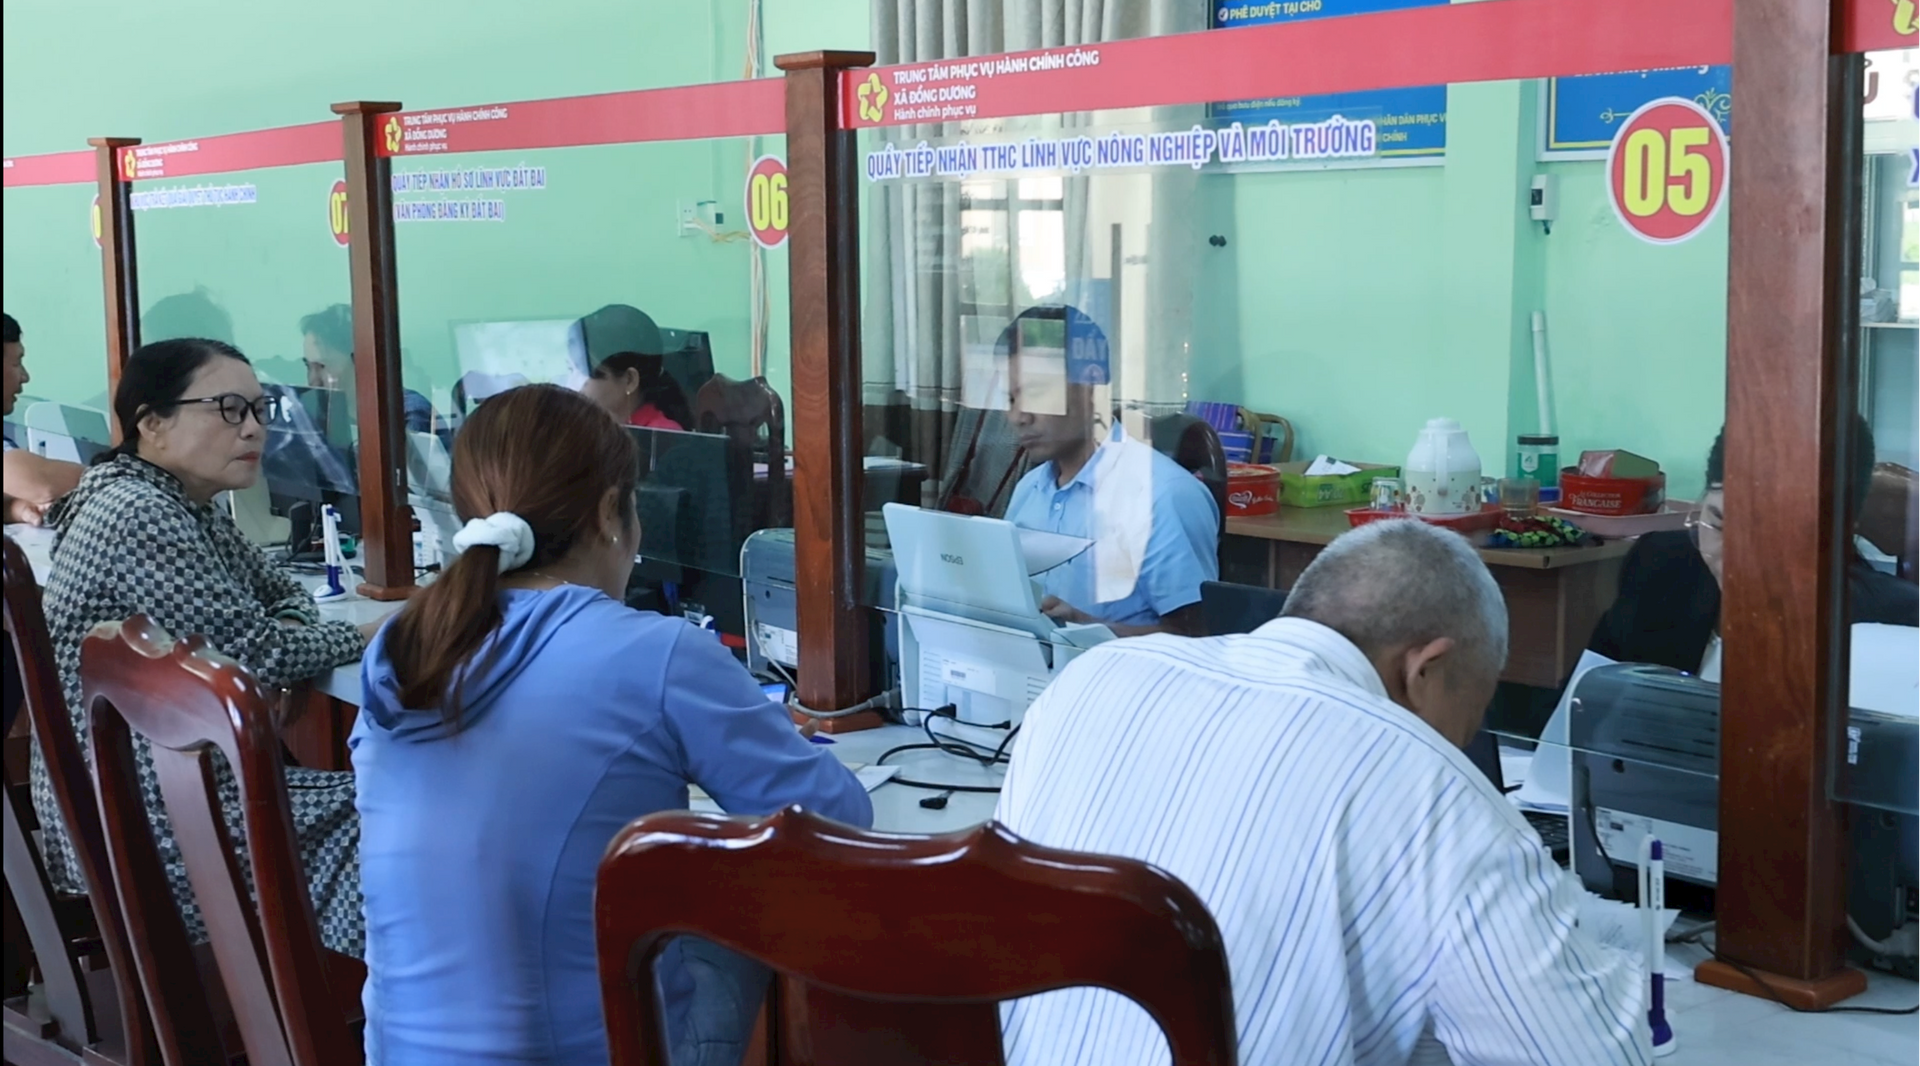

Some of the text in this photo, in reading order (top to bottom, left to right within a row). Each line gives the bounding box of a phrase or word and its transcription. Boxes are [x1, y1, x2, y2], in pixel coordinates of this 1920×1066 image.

[1230, 5, 1248, 20] PHÊ
[1250, 2, 1281, 18] DUYỆT
[1283, 2, 1298, 17] TẠI
[893, 48, 1099, 84] TRUNG TÂM PHỤC VỤ HÀNH CHÍNH CÔNG
[894, 88, 908, 106] XÃ
[939, 85, 976, 101] DƯƠNG
[894, 104, 976, 120] Hành chính phục vụ
[868, 117, 1373, 178] QUẦY TIẾP NHẬN TTHC LĨNH VỰC NÔNG NGHIỆP VÀ MÔI TRƯỜNG
[530, 169, 545, 187] ĐAI
[1624, 127, 1711, 216] 05
[752, 172, 788, 231] 06
[940, 553, 964, 565] EPSON
